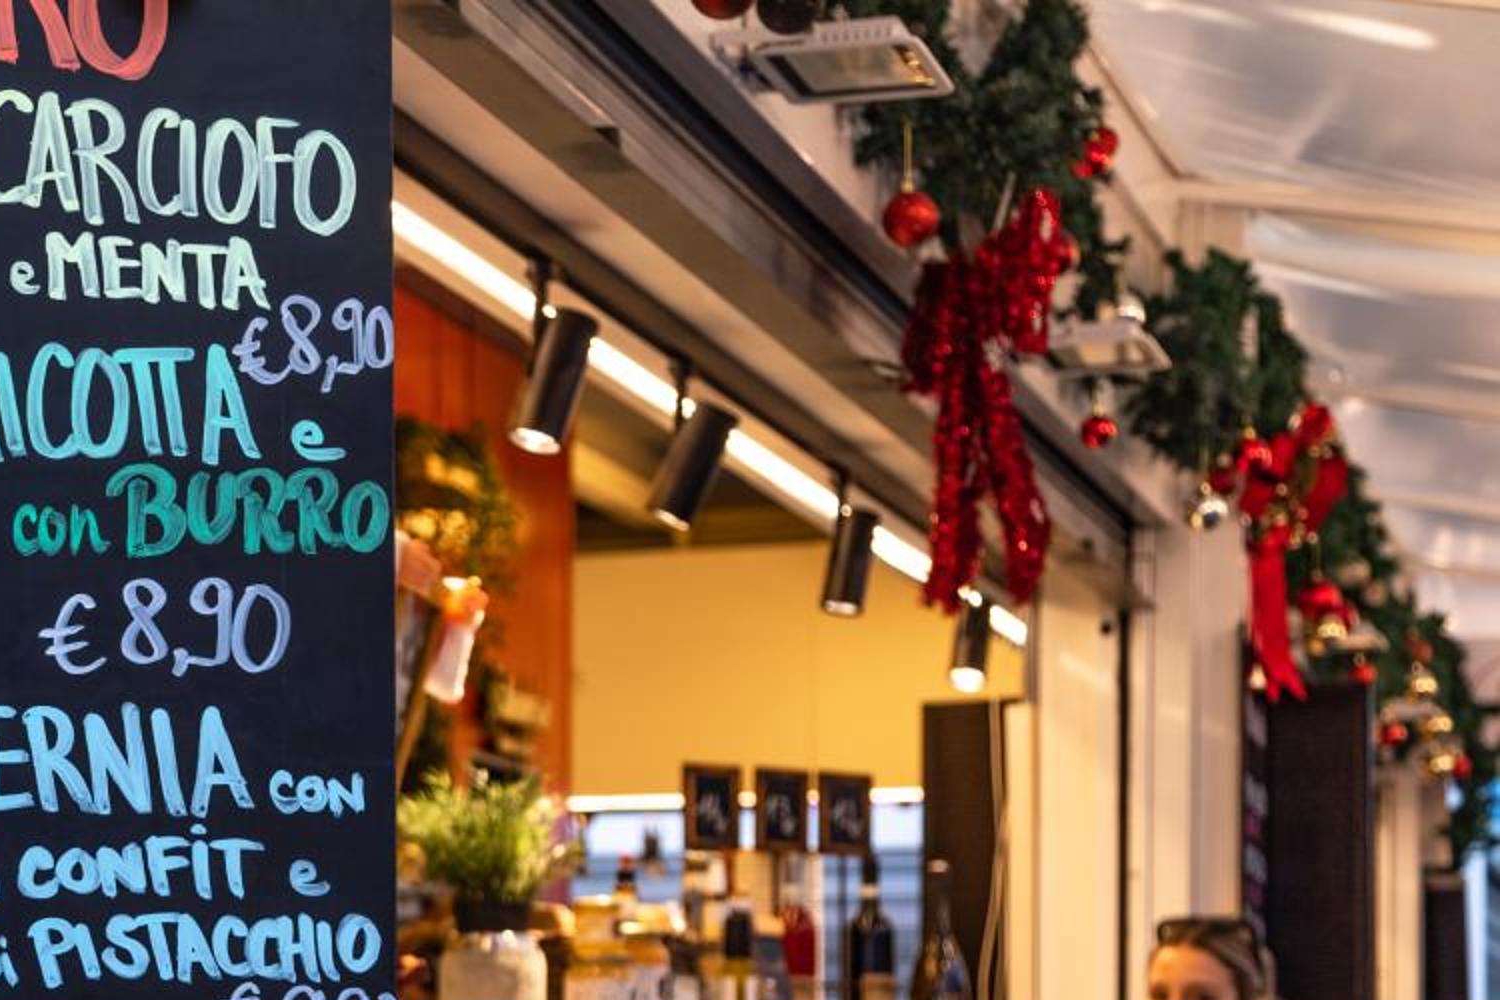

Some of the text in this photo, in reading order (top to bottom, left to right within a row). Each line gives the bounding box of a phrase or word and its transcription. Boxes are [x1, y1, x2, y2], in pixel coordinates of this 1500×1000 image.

[9, 259, 41, 297] e
[46, 231, 271, 311] MENTA
[291, 417, 346, 461] e
[105, 463, 390, 559] BURRO
[269, 769, 365, 815] CON
[289, 856, 330, 896] e
[28, 912, 381, 989] PISTACCHIO
